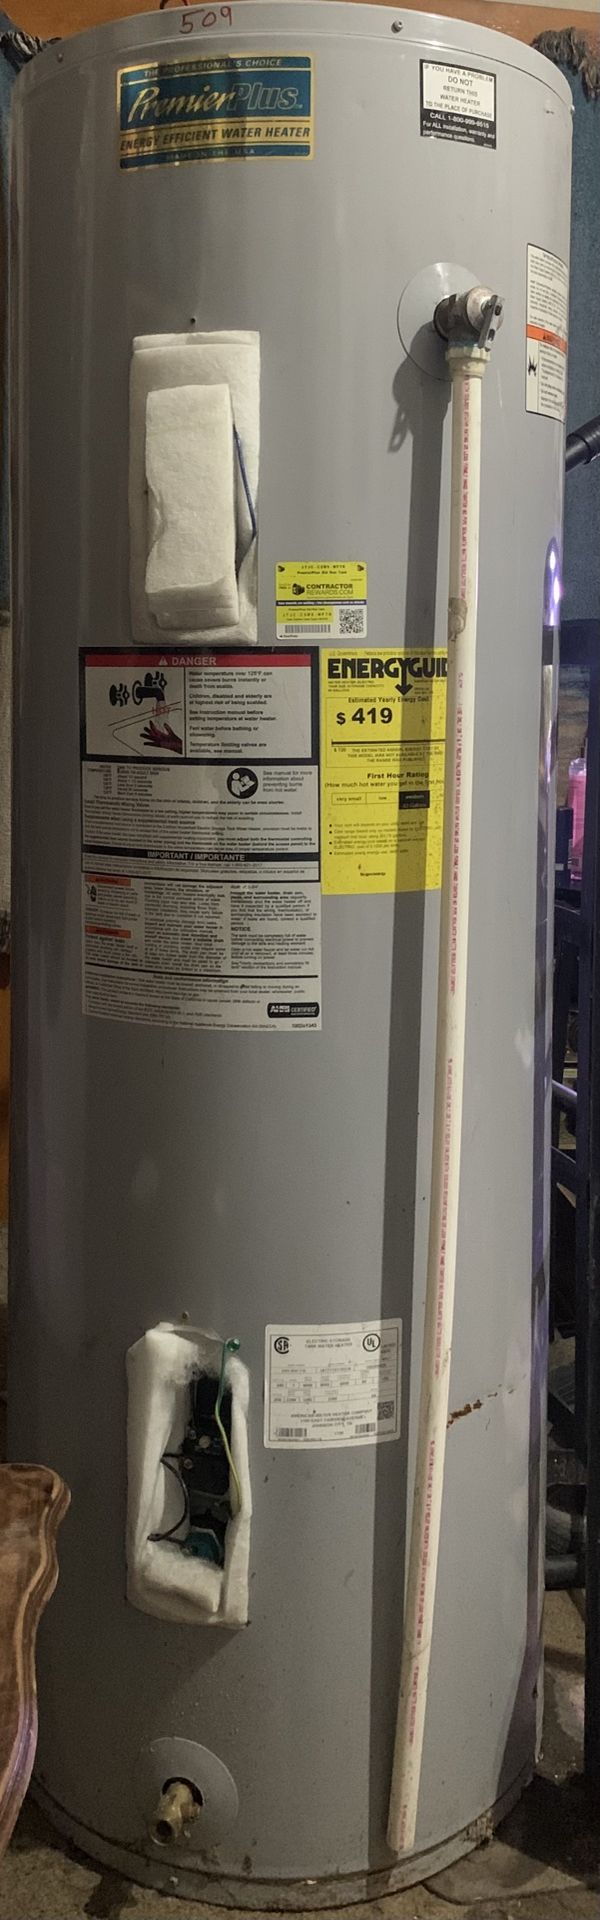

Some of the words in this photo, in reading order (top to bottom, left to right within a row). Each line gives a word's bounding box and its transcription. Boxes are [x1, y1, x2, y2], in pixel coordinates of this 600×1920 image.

[179, 5, 233, 35] 509
[245, 58, 282, 68] CHOICE
[445, 67, 461, 75] HAVE
[447, 76, 458, 84] DO
[459, 78, 473, 87] NOT
[443, 85, 465, 95] RETURN
[460, 98, 480, 106] HEATER
[444, 103, 460, 112] PLACE
[430, 112, 446, 121] CALL
[120, 136, 159, 151] ENERGY
[163, 130, 218, 145] EFFICIENT
[221, 127, 261, 141] WATER
[265, 126, 310, 138] HEATER
[171, 656, 217, 666] DANGER
[328, 658, 447, 694] ENERGYGUI
[336, 712, 346, 725] $
[352, 707, 393, 724] 419
[147, 852, 189, 861] IMPORTANT
[194, 853, 245, 861] IMPORTANTE
